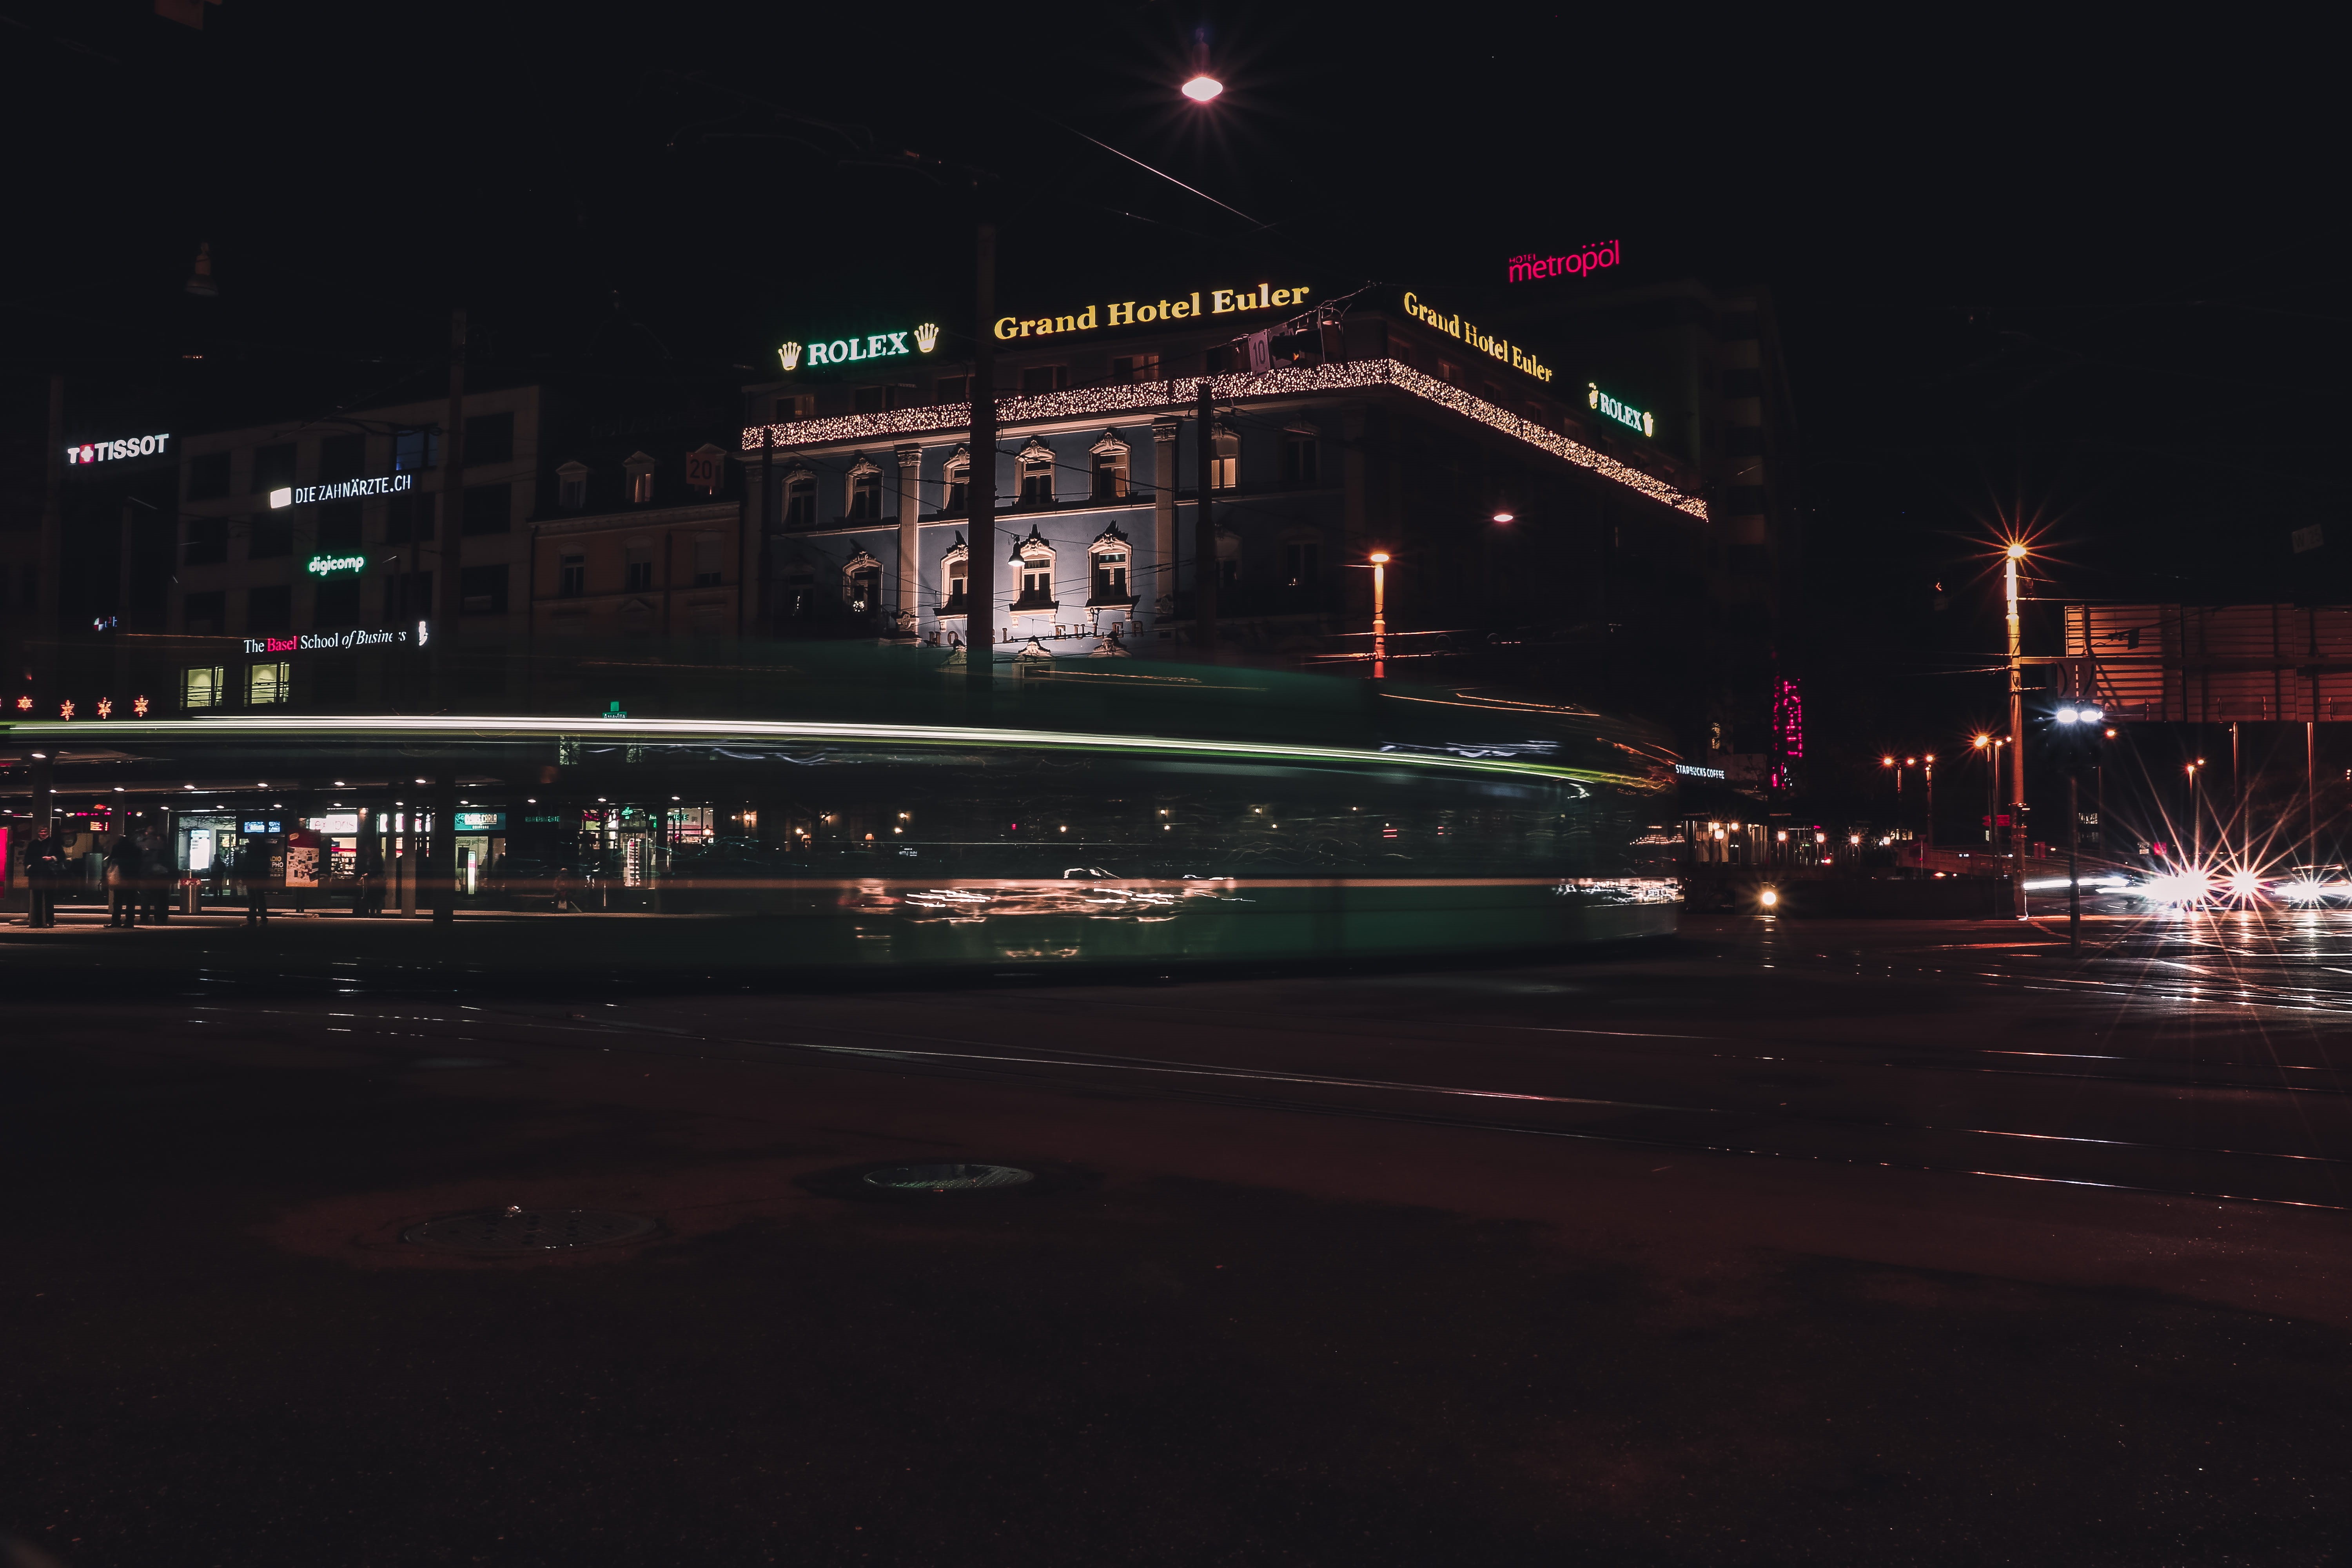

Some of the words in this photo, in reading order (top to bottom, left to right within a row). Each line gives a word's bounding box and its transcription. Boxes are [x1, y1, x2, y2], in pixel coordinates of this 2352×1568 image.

[1509, 254, 1536, 264] HOTEL
[1509, 239, 1619, 283] metropol
[994, 306, 1097, 339] Grand
[1108, 292, 1200, 326] Hotel
[1211, 283, 1309, 313] Euler
[808, 332, 909, 366] ROLEX
[1404, 292, 1460, 338] Grand
[1465, 321, 1508, 362] Hotel
[1512, 346, 1552, 382] Euler
[1253, 339, 1266, 367] 10
[1600, 393, 1642, 432] ROLEX
[690, 458, 712, 479] 20
[296, 486, 316, 504] DIE
[319, 474, 410, 501] ZAHNÄRZTE.CH
[309, 555, 363, 576] digicomp
[244, 639, 265, 653] The
[267, 636, 297, 652] Basel
[300, 633, 339, 650] School
[342, 630, 356, 649] of
[356, 630, 407, 645] Busines
[929, 628, 1014, 645] HOL
[1675, 764, 1706, 777] STARBUCKS
[1707, 768, 1724, 779] COFFEE
